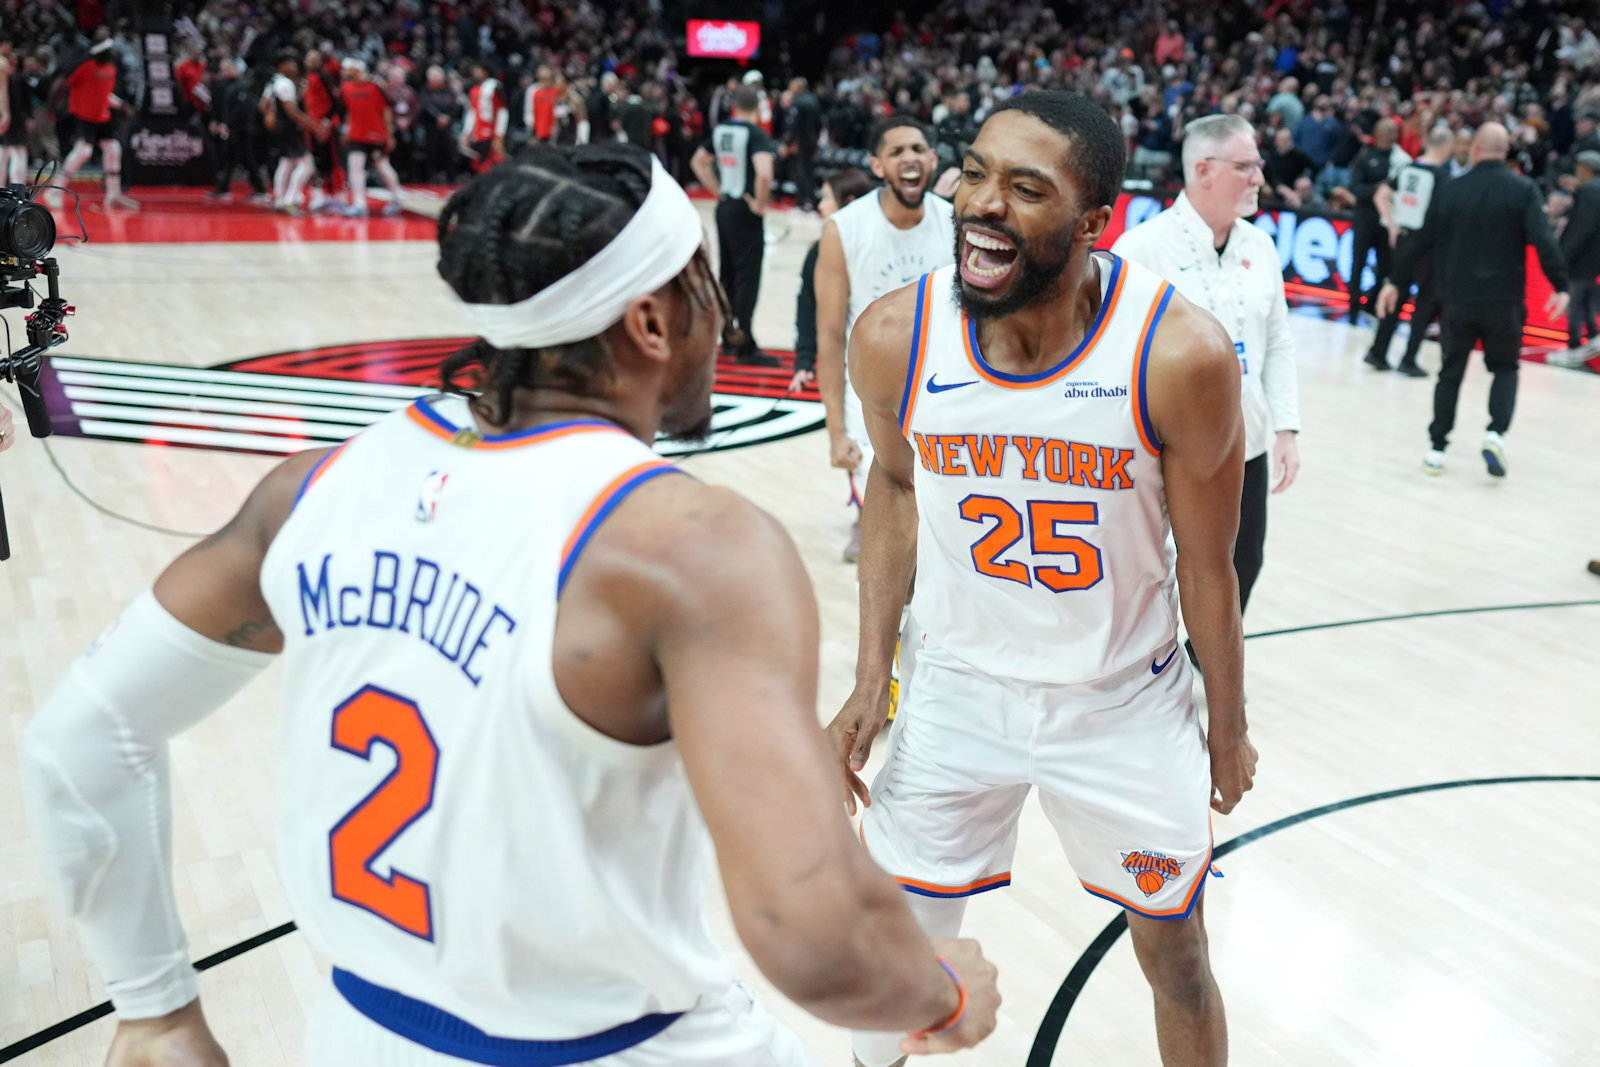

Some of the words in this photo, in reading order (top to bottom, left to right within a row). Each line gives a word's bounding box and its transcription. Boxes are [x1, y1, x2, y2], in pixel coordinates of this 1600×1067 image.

[1064, 387, 1089, 398] abu
[1090, 385, 1127, 397] dhabi
[914, 432, 1008, 477] NEW
[1012, 435, 1135, 490] YORK
[958, 493, 1104, 594] 25
[297, 550, 516, 686] McBRIDE
[329, 683, 441, 943] 2
[1121, 851, 1182, 876] KNICKS
